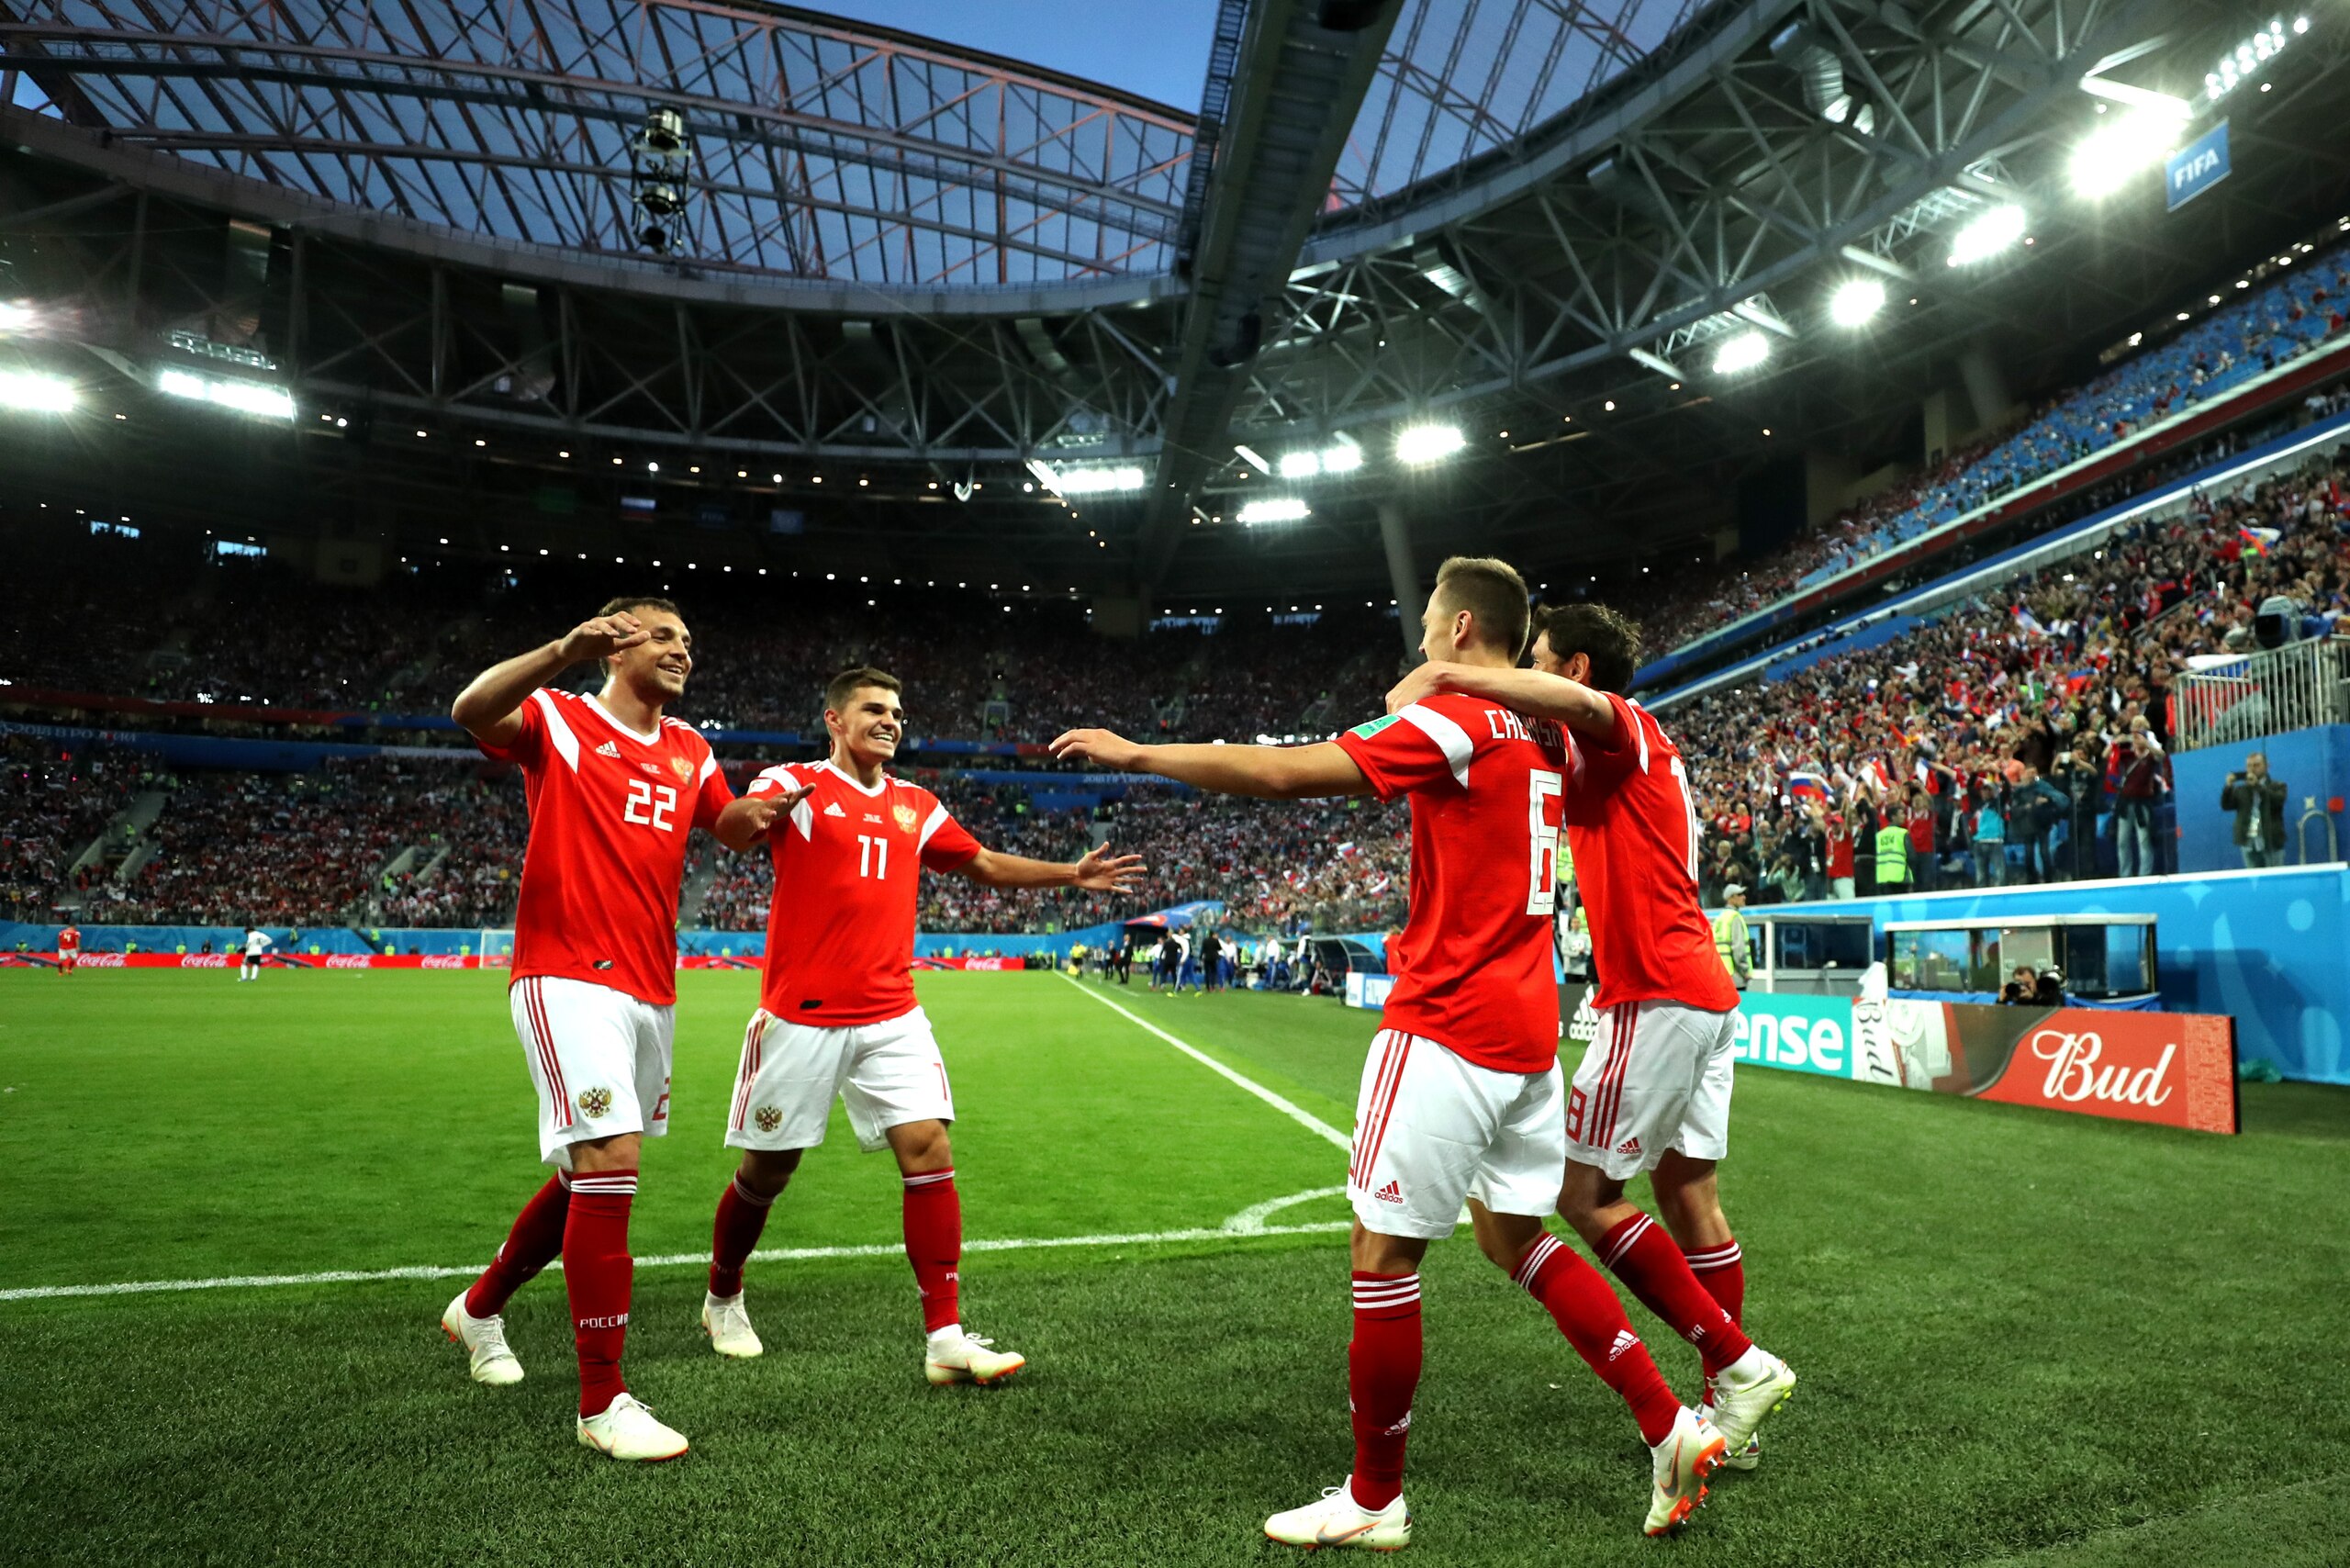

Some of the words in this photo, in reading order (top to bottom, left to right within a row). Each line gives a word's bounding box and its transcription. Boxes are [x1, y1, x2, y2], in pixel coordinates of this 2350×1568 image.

[2174, 148, 2220, 190] FIFA
[595, 747, 621, 759] adidas
[623, 778, 677, 833] 22
[1526, 768, 1562, 915] 6
[857, 834, 888, 880] 11
[77, 953, 127, 968] Coca-Cola
[181, 953, 229, 968] Coca-Cola
[326, 954, 371, 969] Coca-Cola
[421, 955, 464, 969] Coca-Cola
[2031, 1029, 2177, 1107] Bud
[1374, 1192, 1404, 1204] adidas
[1608, 1337, 1641, 1361] adidas
